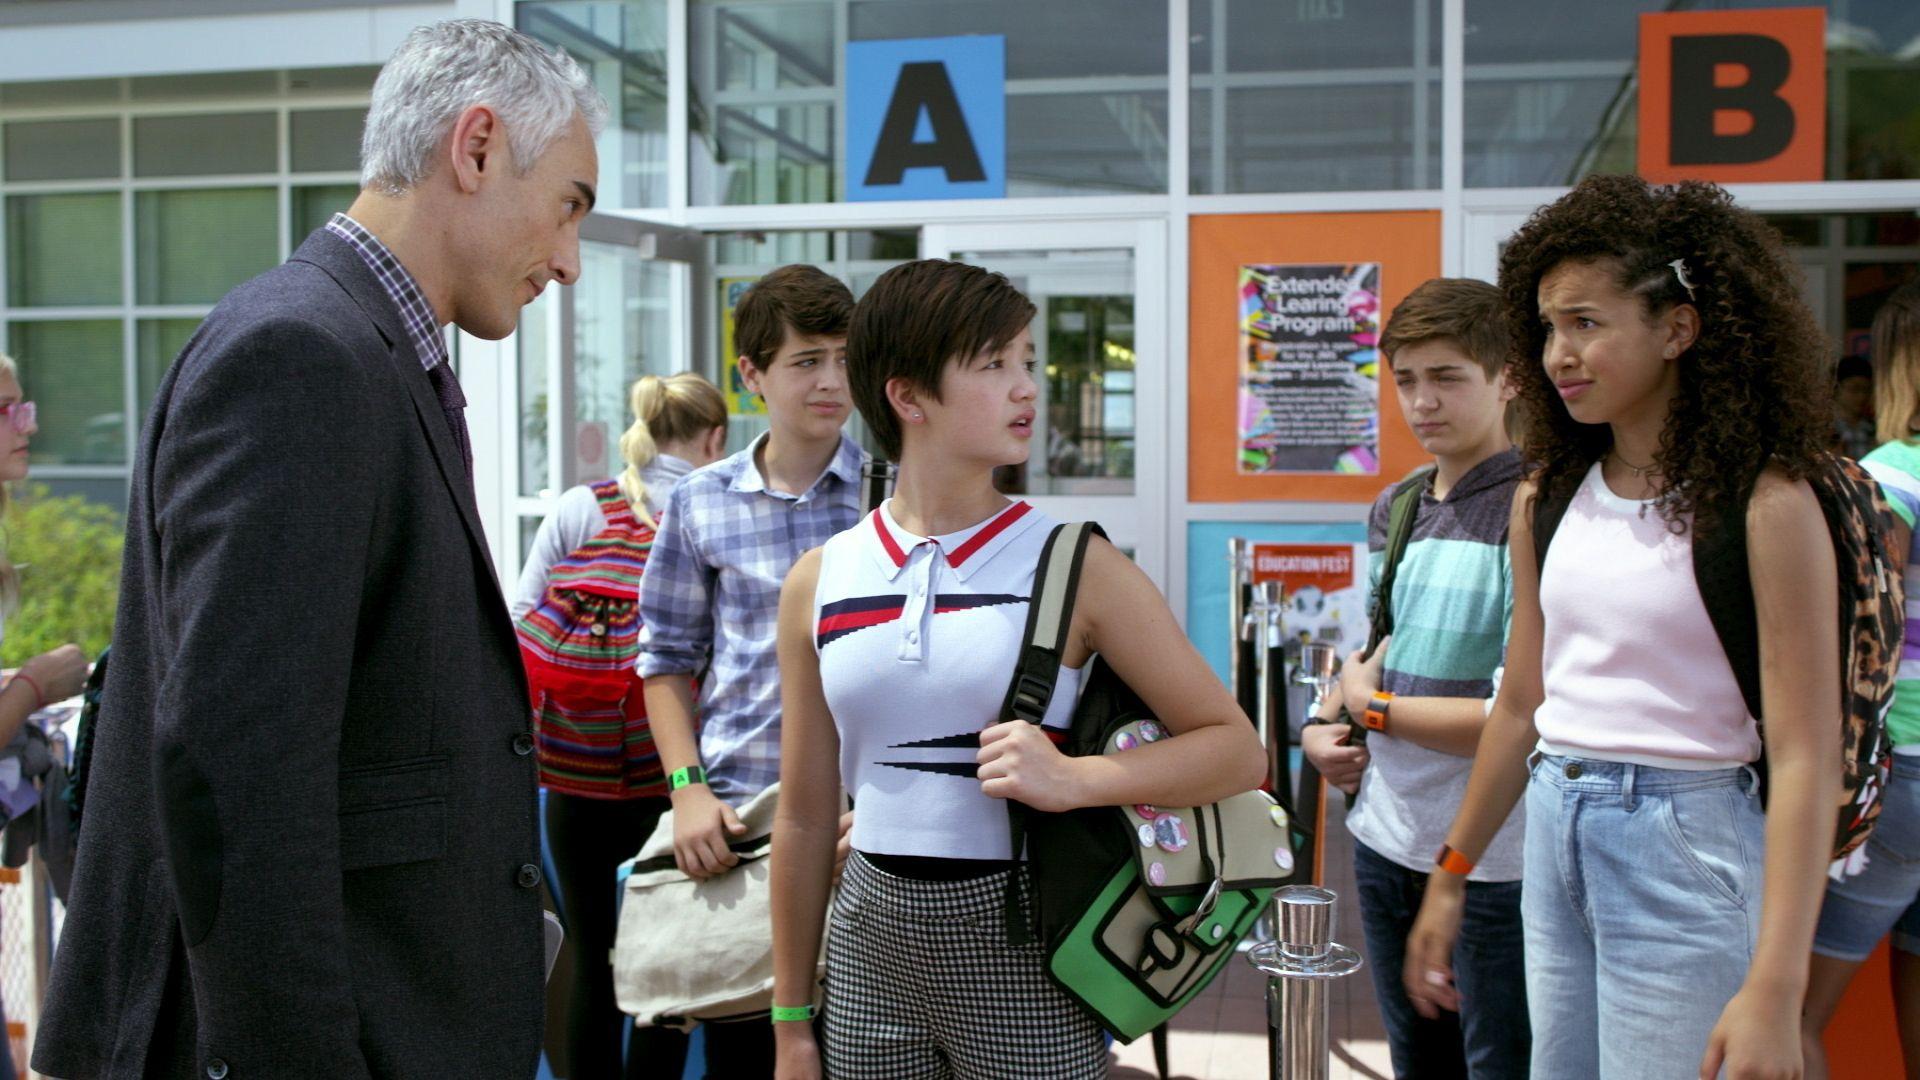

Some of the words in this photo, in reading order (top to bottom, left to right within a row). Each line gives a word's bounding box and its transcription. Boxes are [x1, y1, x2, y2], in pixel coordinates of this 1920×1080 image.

[1668, 33, 1796, 166] B
[862, 61, 988, 186] A
[1277, 295, 1349, 315] Learing
[1271, 314, 1356, 336] Program
[1258, 556, 1319, 571] EDUCATION
[1321, 556, 1350, 573] FEST
